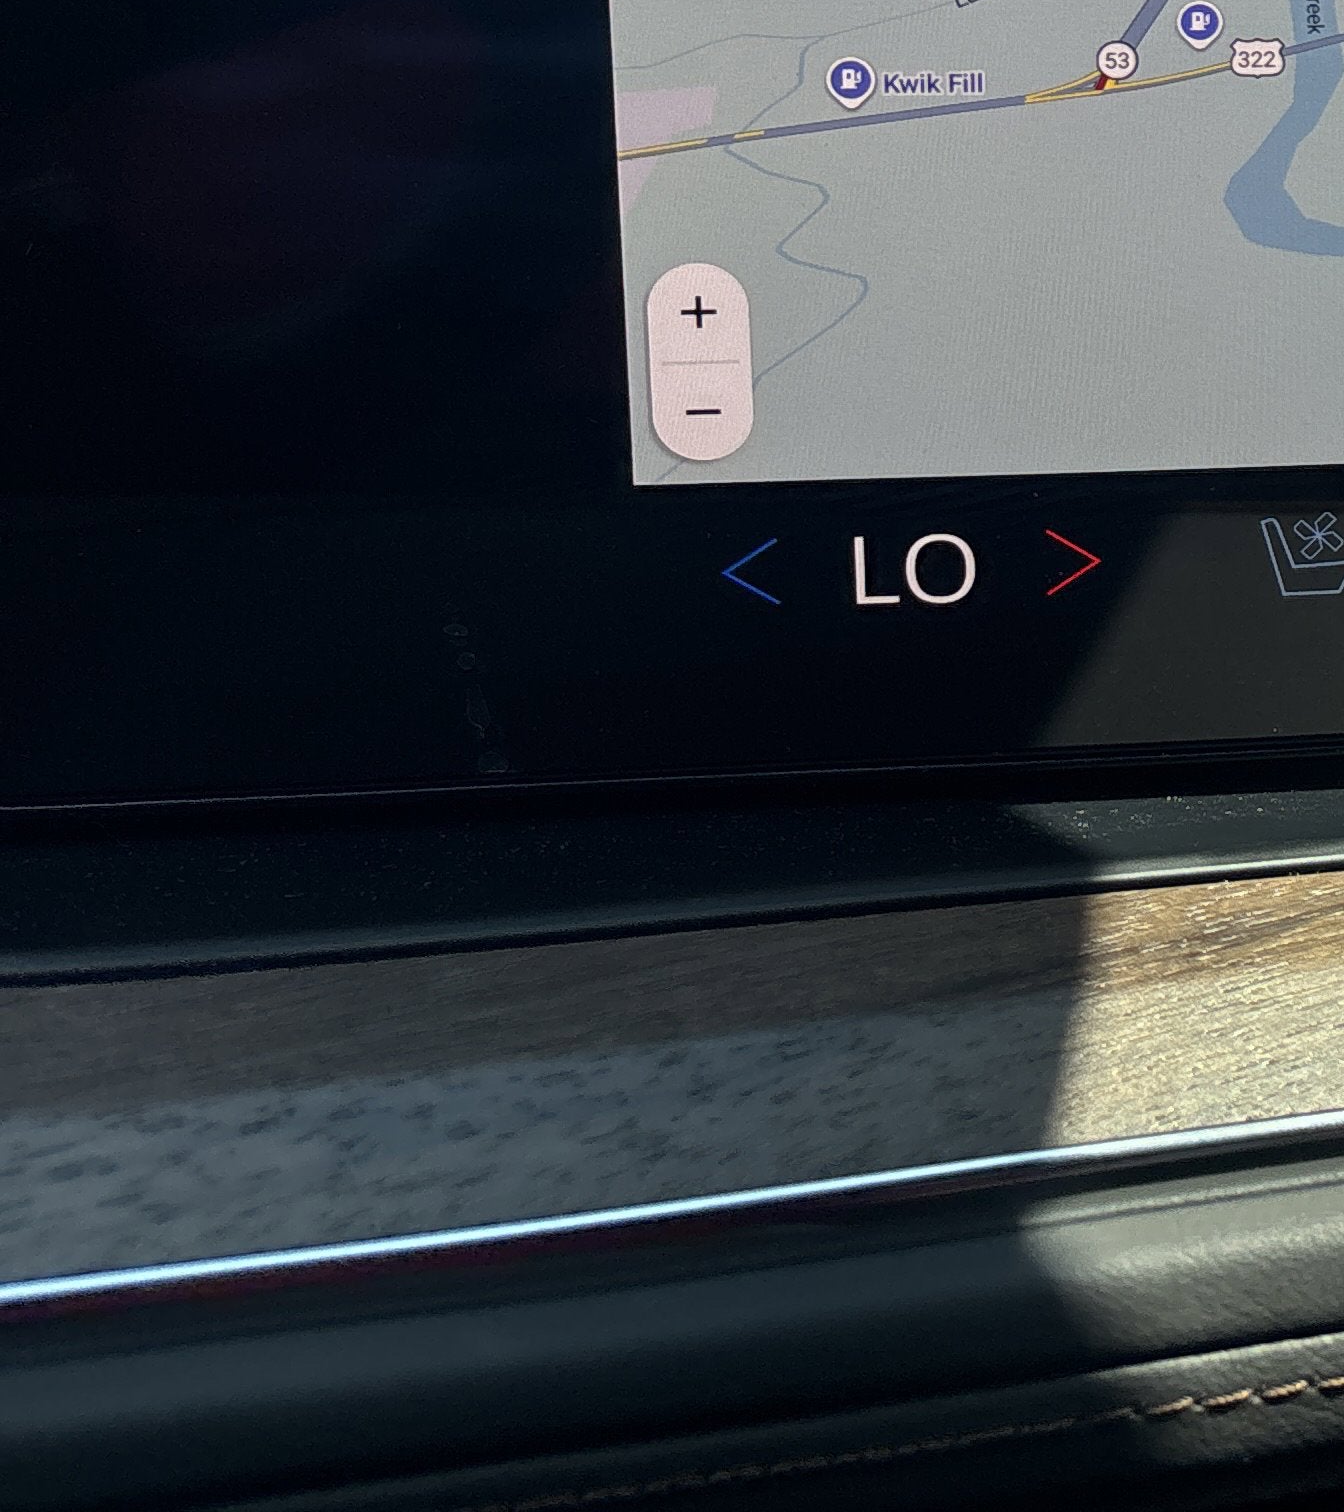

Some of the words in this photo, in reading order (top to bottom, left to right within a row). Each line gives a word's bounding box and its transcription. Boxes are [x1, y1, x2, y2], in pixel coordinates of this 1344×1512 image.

[1105, 52, 1129, 69] 53
[1238, 50, 1277, 68] 322
[883, 74, 941, 94] Kwik
[949, 73, 984, 93] Fill
[855, 532, 977, 607] LO
